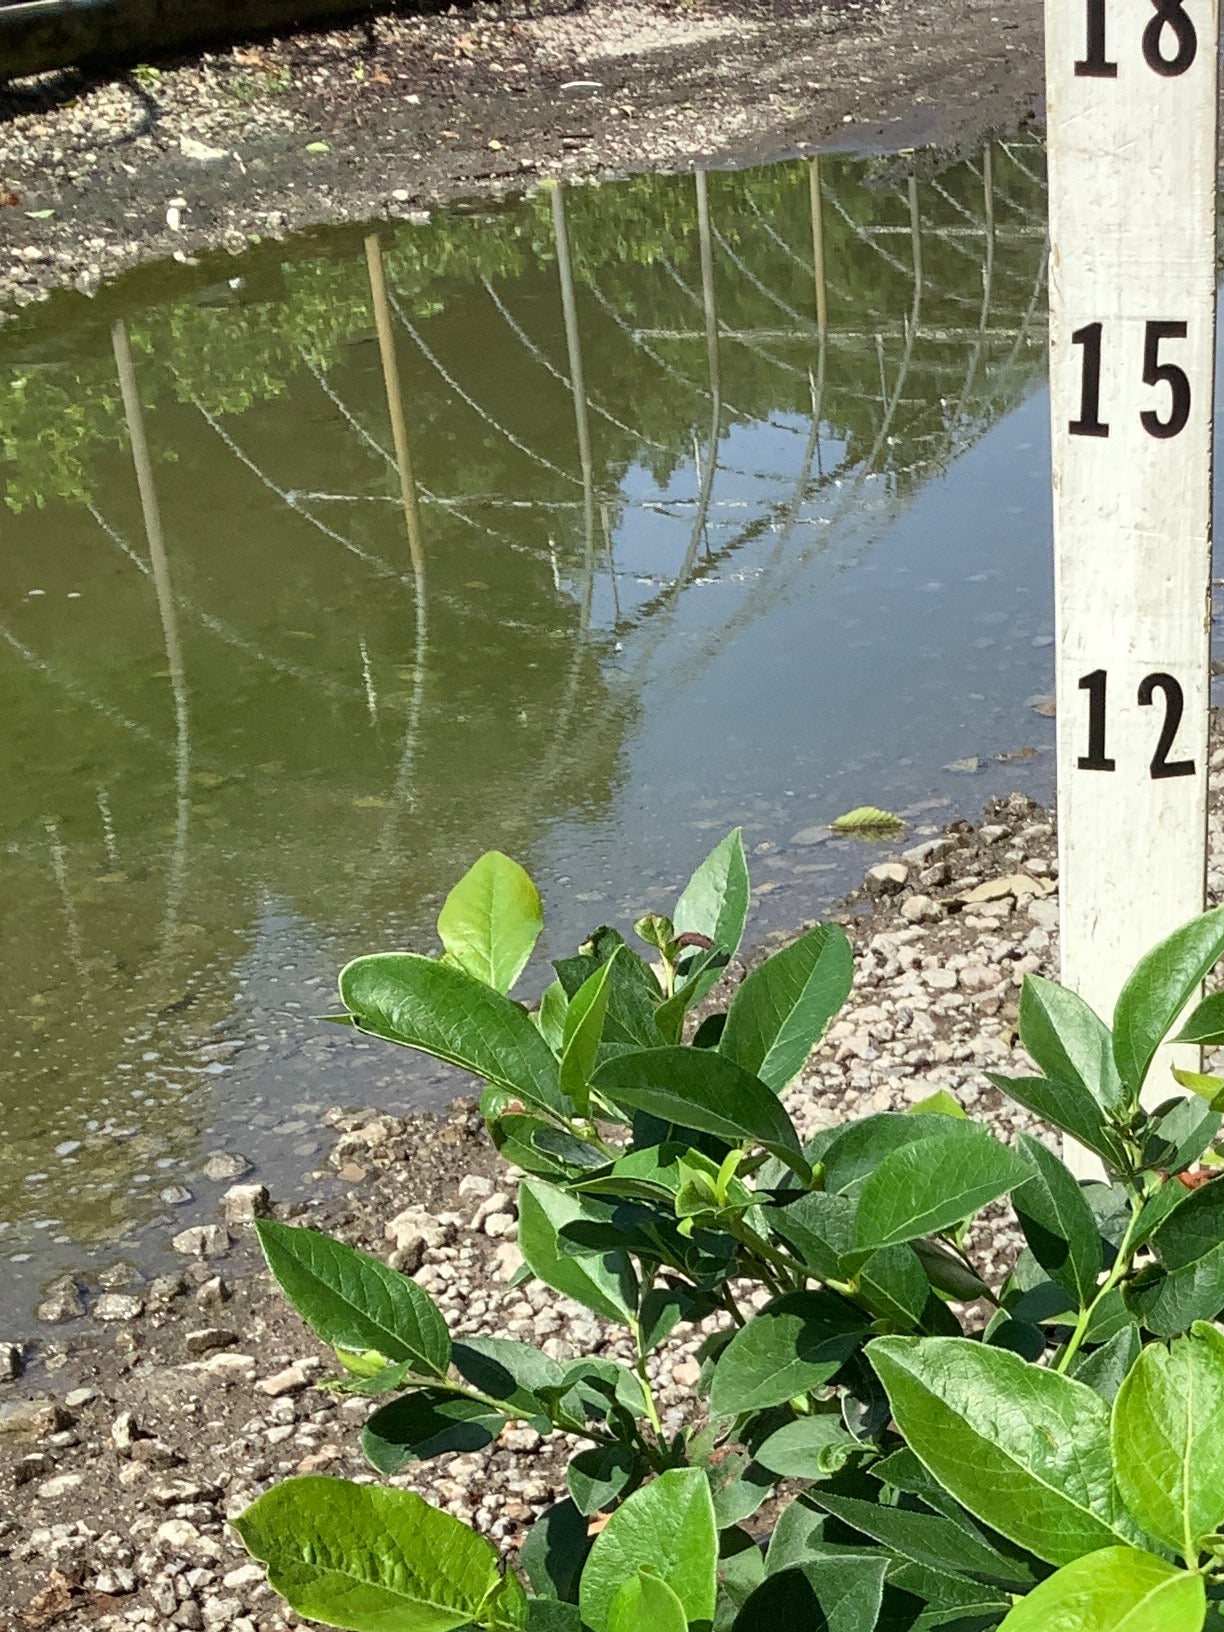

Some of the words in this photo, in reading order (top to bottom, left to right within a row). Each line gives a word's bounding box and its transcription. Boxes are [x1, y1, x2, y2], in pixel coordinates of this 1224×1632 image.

[1074, 0, 1198, 78] 18
[1068, 320, 1191, 439] 15
[1077, 669, 1196, 780] 12
